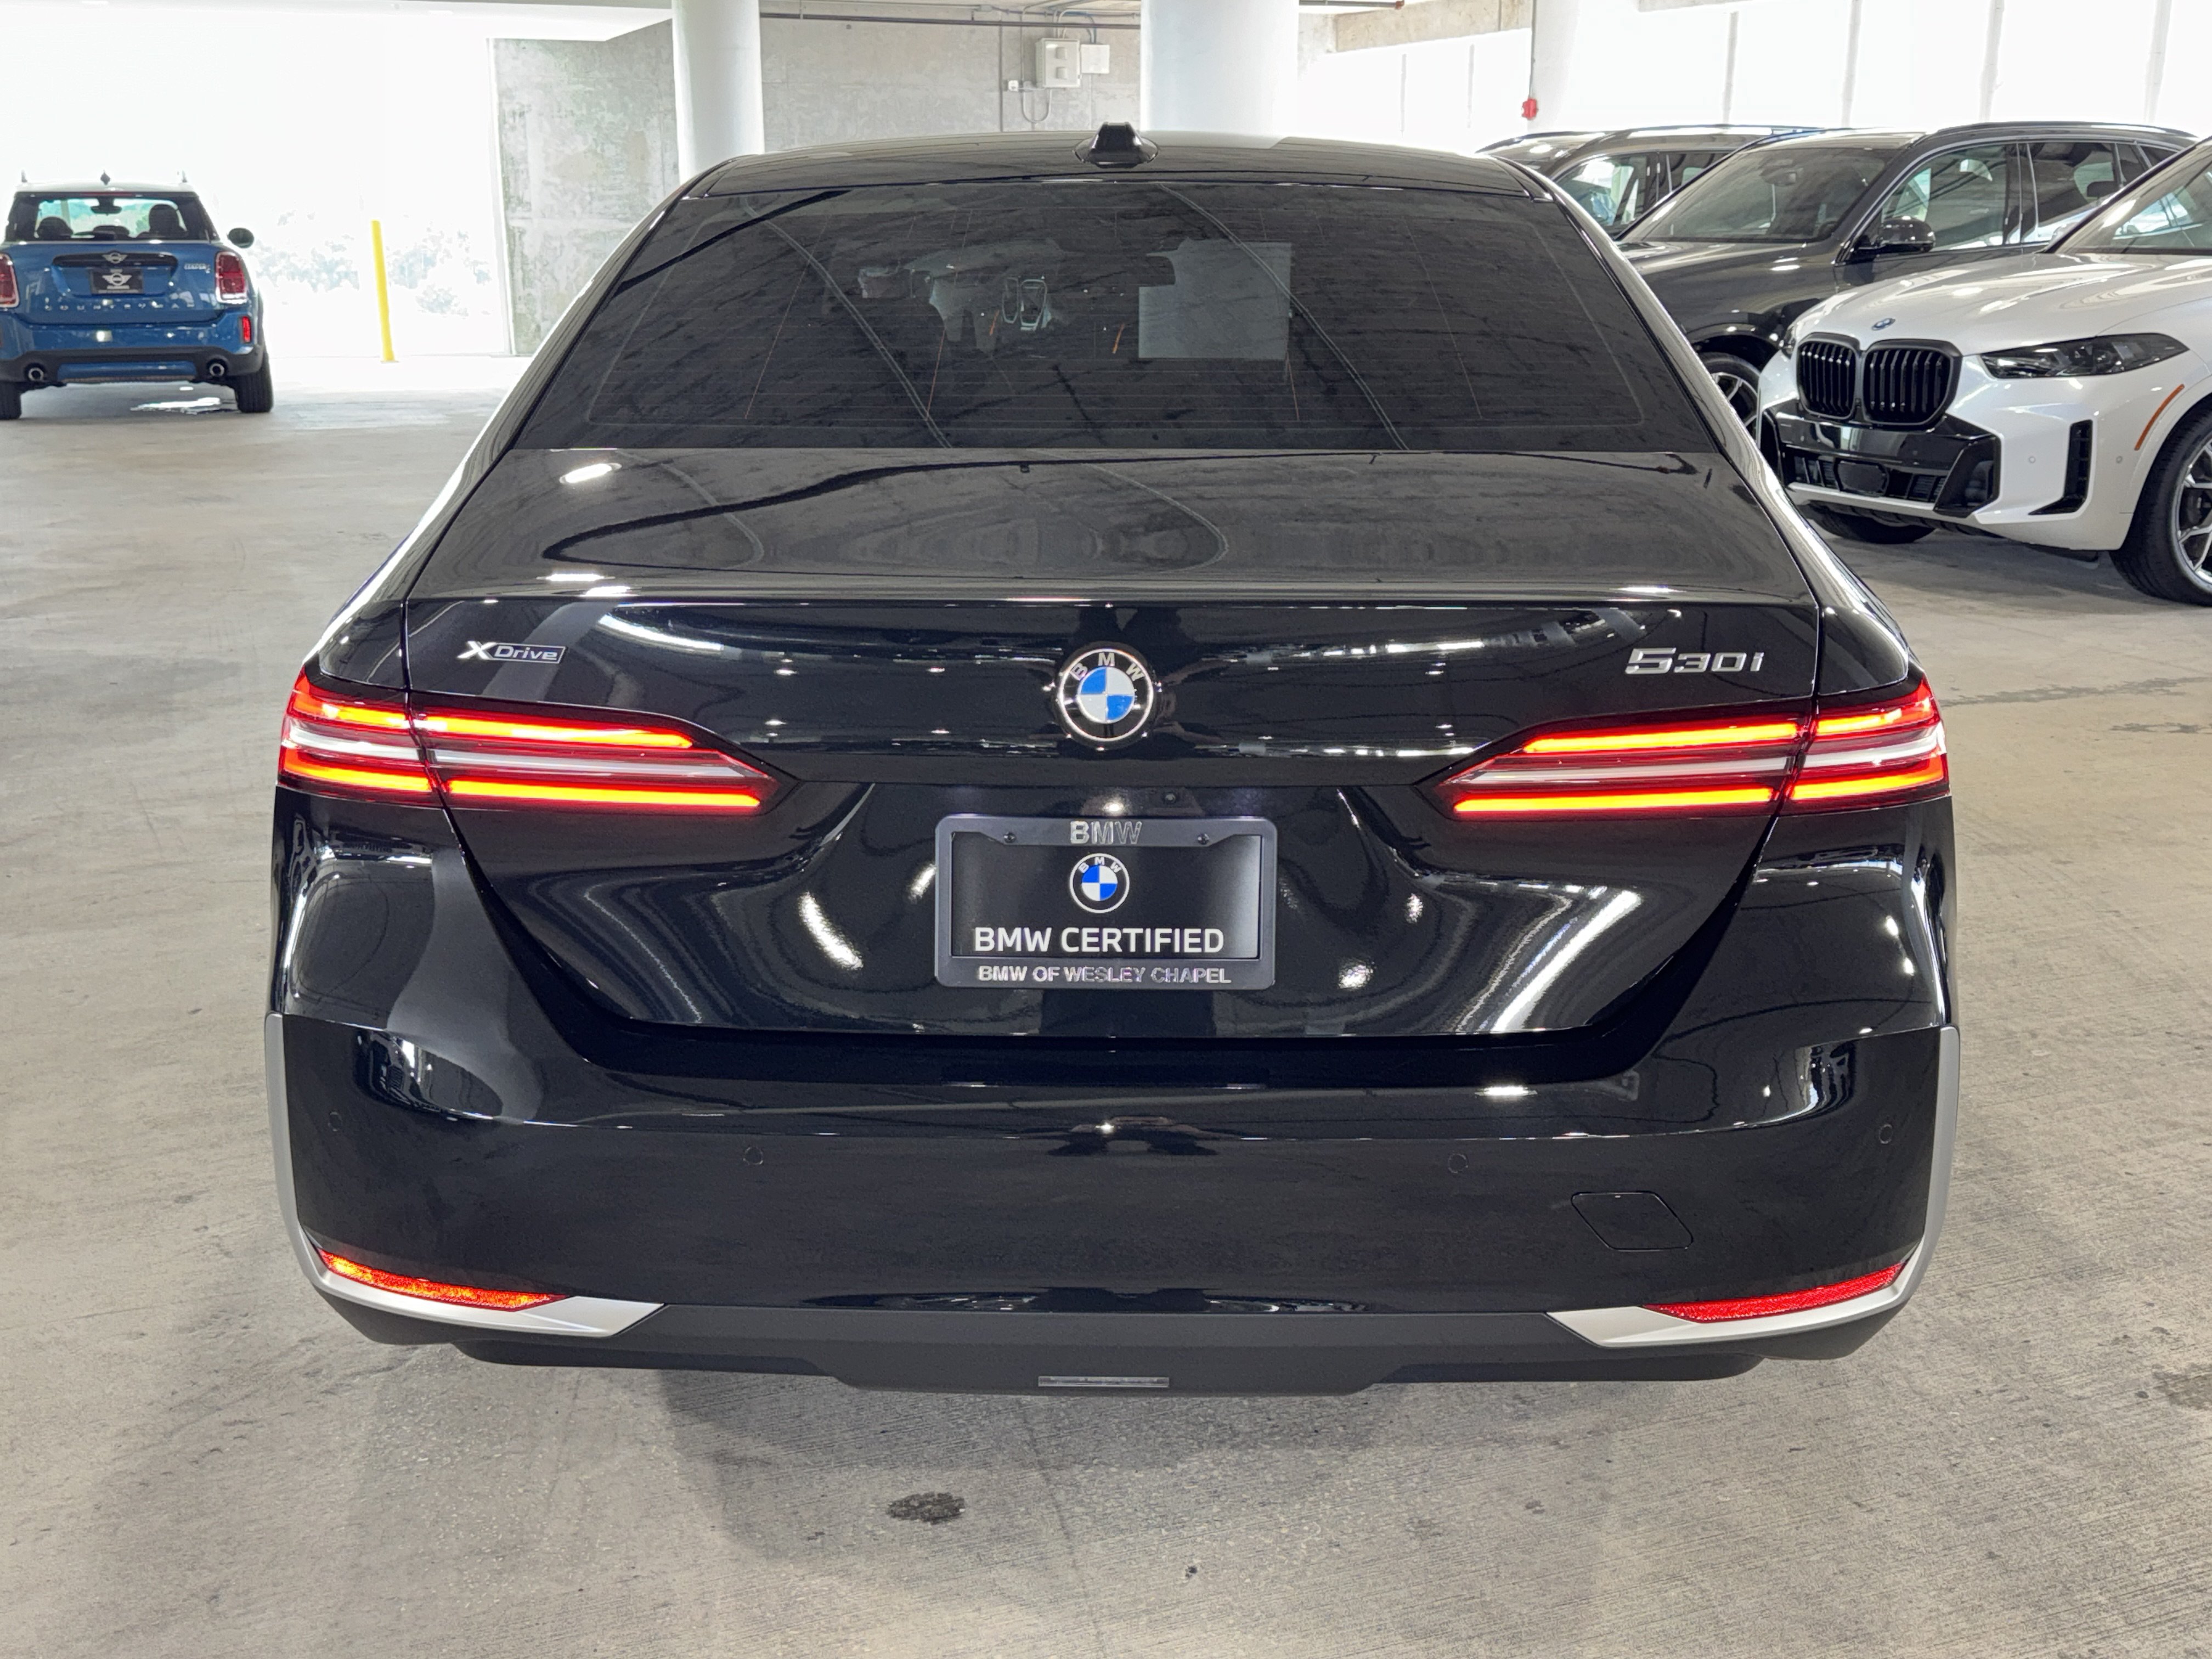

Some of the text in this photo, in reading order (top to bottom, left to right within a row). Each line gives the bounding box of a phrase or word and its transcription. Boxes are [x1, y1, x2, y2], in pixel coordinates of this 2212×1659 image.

[1069, 652, 1145, 681] BMW
[1625, 647, 1764, 674] 530i
[1070, 821, 1142, 845] BMW
[1078, 856, 1122, 873] BMW
[974, 927, 1224, 953] BMW CERTIFIED
[978, 966, 1232, 984] BMW OF WESLEY CHAPEL
